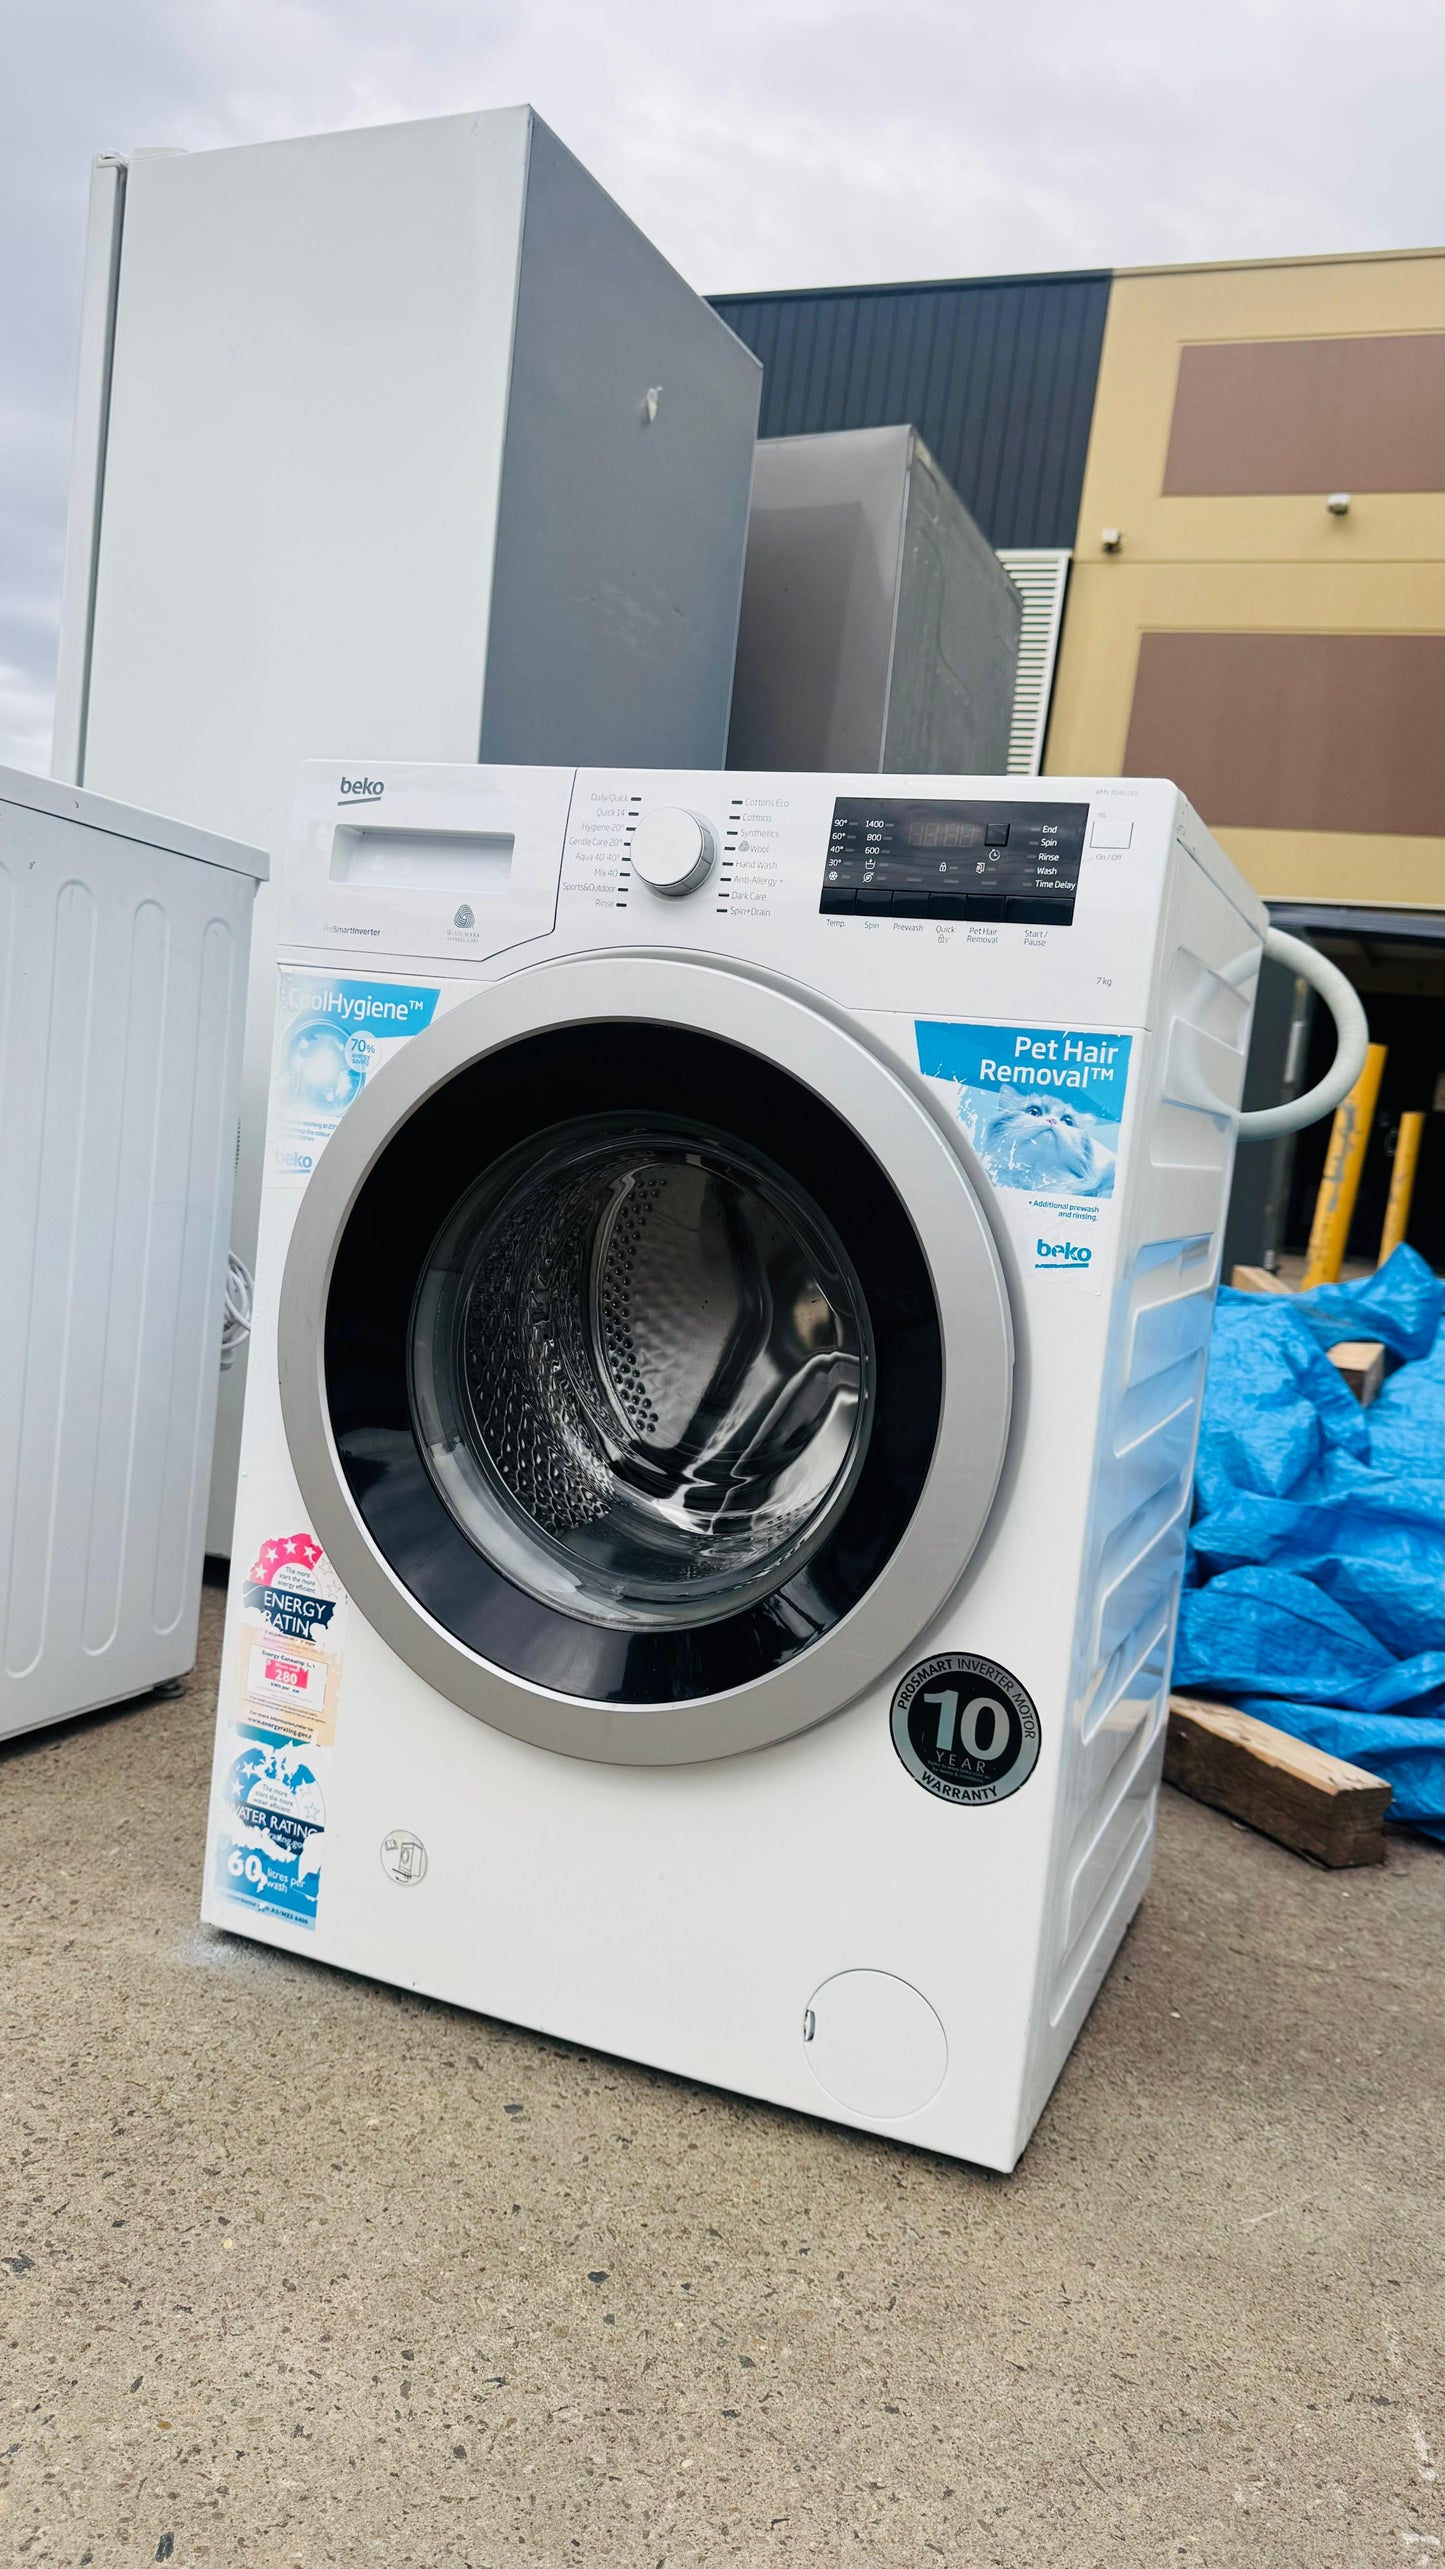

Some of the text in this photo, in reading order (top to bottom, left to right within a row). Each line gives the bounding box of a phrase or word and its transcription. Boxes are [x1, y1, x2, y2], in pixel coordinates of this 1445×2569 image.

[340, 776, 385, 796] beko
[744, 797, 789, 807] Cottons Eco
[596, 807, 616, 817] Quick
[742, 813, 772, 822] Cottons
[581, 823, 610, 832] Hygiene
[834, 819, 848, 827] 90°
[865, 820, 884, 828] 1400
[740, 828, 780, 839] Synthetics
[1042, 825, 1058, 834] End
[832, 832, 846, 840] 60°
[866, 833, 882, 842] 800
[568, 837, 592, 846] Gentle
[592, 837, 608, 846] Care
[1040, 838, 1058, 848] Spin
[750, 844, 769, 853] Wool
[830, 845, 844, 853] 40°
[864, 846, 880, 855] 600
[575, 852, 593, 862] Aqua
[1038, 852, 1060, 861] Rinse
[735, 859, 777, 870] Hand Wash
[828, 859, 842, 867] 30°
[594, 868, 606, 877] Mix
[1037, 866, 1058, 875] Wash
[733, 875, 777, 887] Anti-Allergy
[1035, 879, 1076, 891] Time Delay
[562, 882, 616, 892] Sports&Outdoor
[731, 890, 767, 901] Dark Care
[595, 898, 614, 908] Rinse
[730, 906, 771, 917] Spin+Drain
[323, 924, 381, 937] ProSmartInverter
[864, 921, 880, 930] Spin
[893, 922, 924, 932] Prewash
[935, 925, 955, 934] Quick
[968, 926, 998, 936] Pet Hair
[1024, 929, 1043, 938] Start
[966, 935, 998, 944] Removal
[1023, 938, 1047, 947] Pause
[351, 1038, 376, 1054] 70%
[1014, 1036, 1119, 1064] Pet Hair
[275, 1149, 313, 1168] beko
[1033, 1200, 1099, 1213] Additional prewash
[1058, 1210, 1073, 1218] and
[1037, 1239, 1092, 1262] beko
[286, 1566, 311, 1579] The more
[279, 1573, 316, 1587] stars the more
[277, 1580, 316, 1594] energy efficient
[264, 1590, 327, 1620] ENERGY
[264, 1609, 315, 1638] RATIN
[261, 1650, 280, 1659] Energy
[275, 1668, 298, 1684] 280
[898, 1658, 1037, 1739] PROSMART INVERTER MOTOR
[923, 1689, 1011, 1761] 10
[936, 1750, 986, 1774] YEAR
[263, 1783, 288, 1797] The more
[921, 1770, 998, 1801] WARRANTY
[255, 1791, 294, 1807] stars the more
[253, 1798, 291, 1813] water efficient
[227, 1850, 263, 1883] 60
[266, 1879, 288, 1894] wash
[290, 1875, 305, 1889] per
